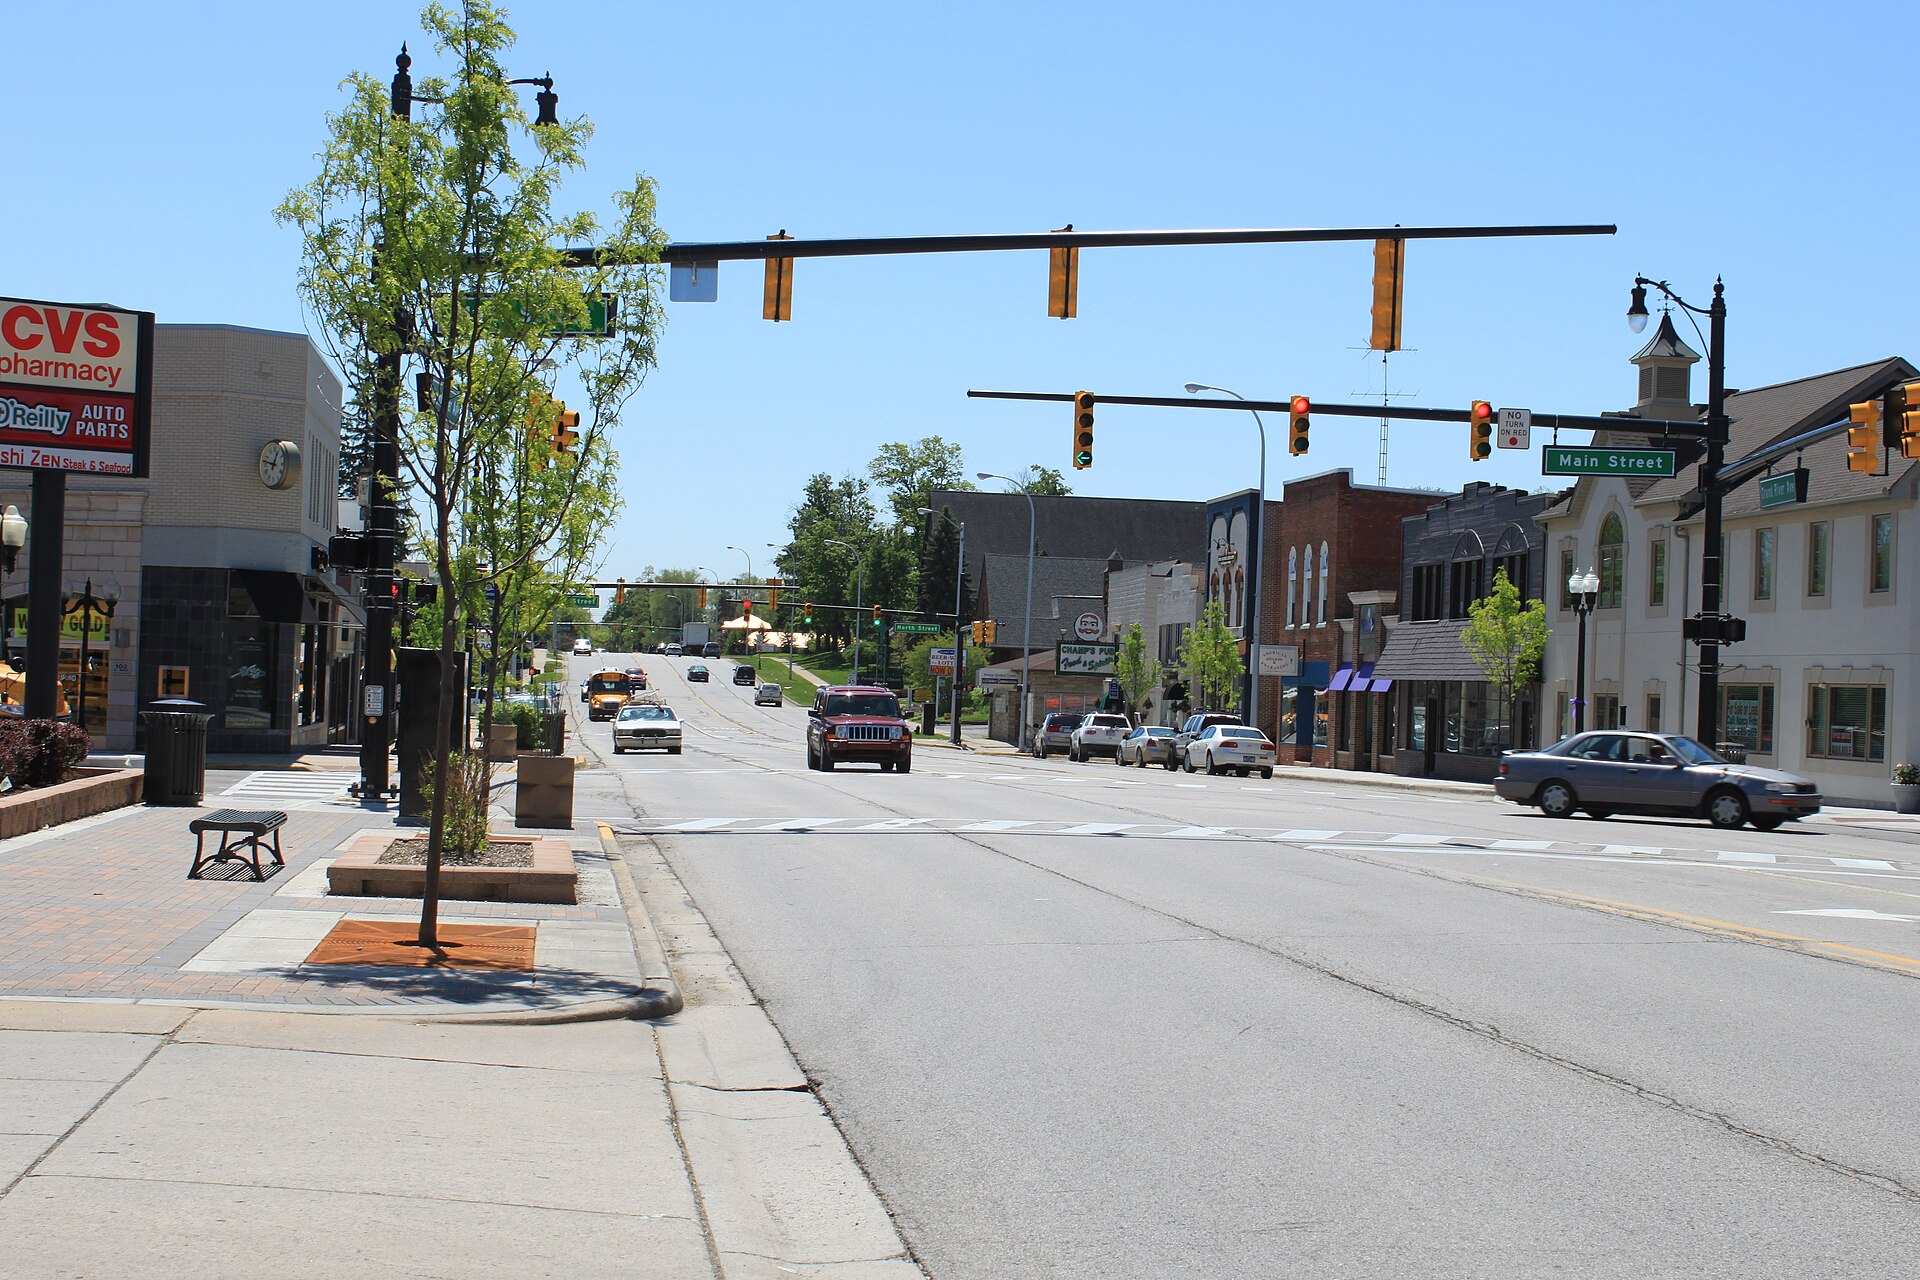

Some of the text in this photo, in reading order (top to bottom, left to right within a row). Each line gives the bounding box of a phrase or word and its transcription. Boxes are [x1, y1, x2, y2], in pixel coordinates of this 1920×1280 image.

[2, 305, 121, 358] CVS
[0, 352, 122, 388] pharmacy
[0, 399, 70, 432] O'Reilly
[82, 404, 125, 422] AUTO
[1507, 411, 1522, 420] NO
[76, 421, 129, 439] PARTS
[1500, 428, 1528, 437] ON RED
[63, 458, 87, 470] Steak
[90, 460, 96, 471] &
[99, 461, 131, 474] Seafood
[1559, 454, 1663, 469] Main Street
[1062, 645, 1115, 655] CHAMP'S PUB
